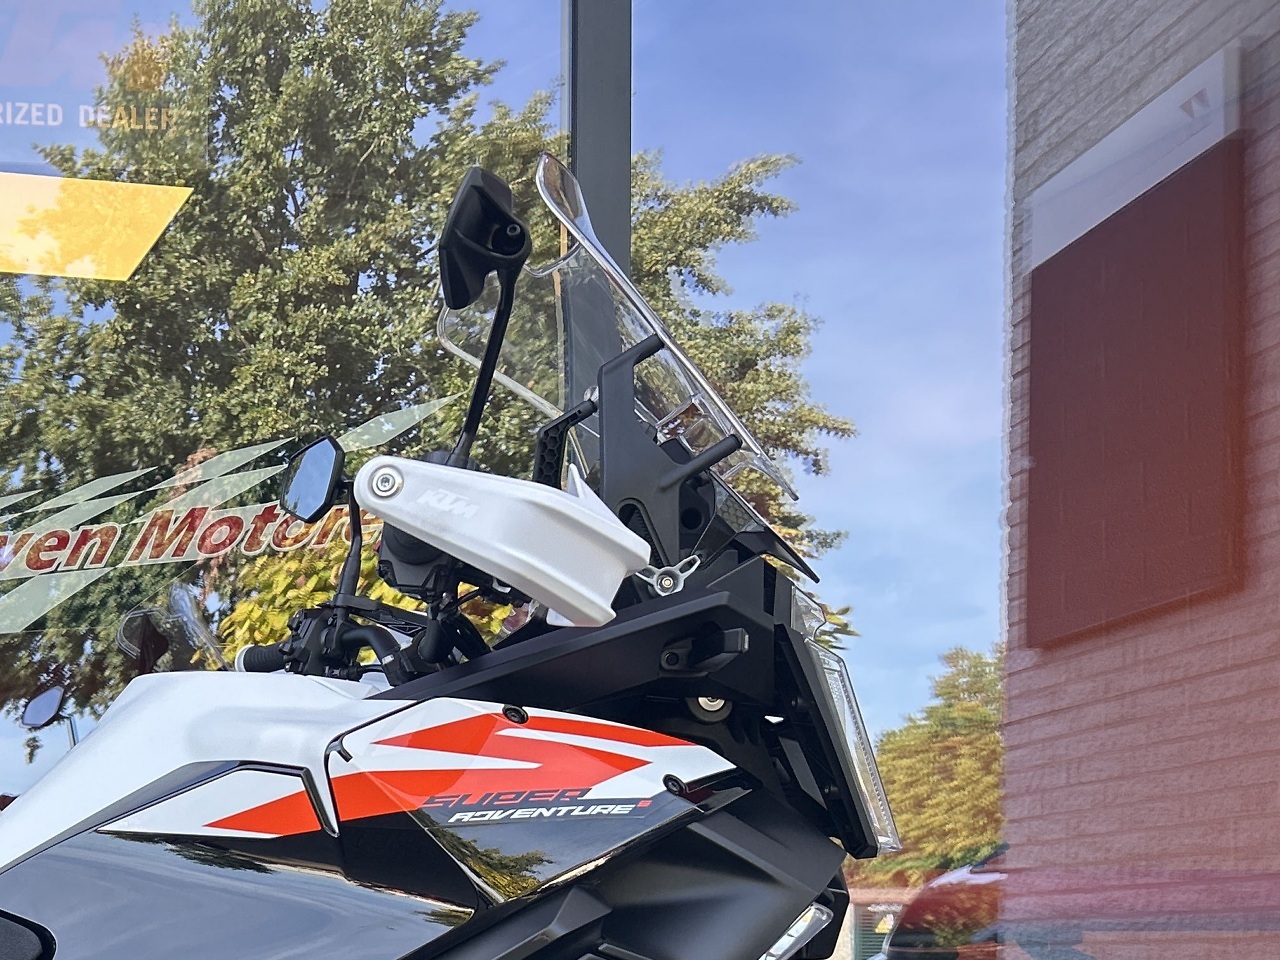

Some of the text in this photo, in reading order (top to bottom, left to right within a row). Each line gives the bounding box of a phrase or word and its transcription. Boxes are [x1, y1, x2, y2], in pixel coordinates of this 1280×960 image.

[78, 103, 176, 131] DEALER
[416, 488, 480, 518] KTM
[420, 787, 593, 808] SUPER
[447, 803, 636, 823] ADVENTURE
